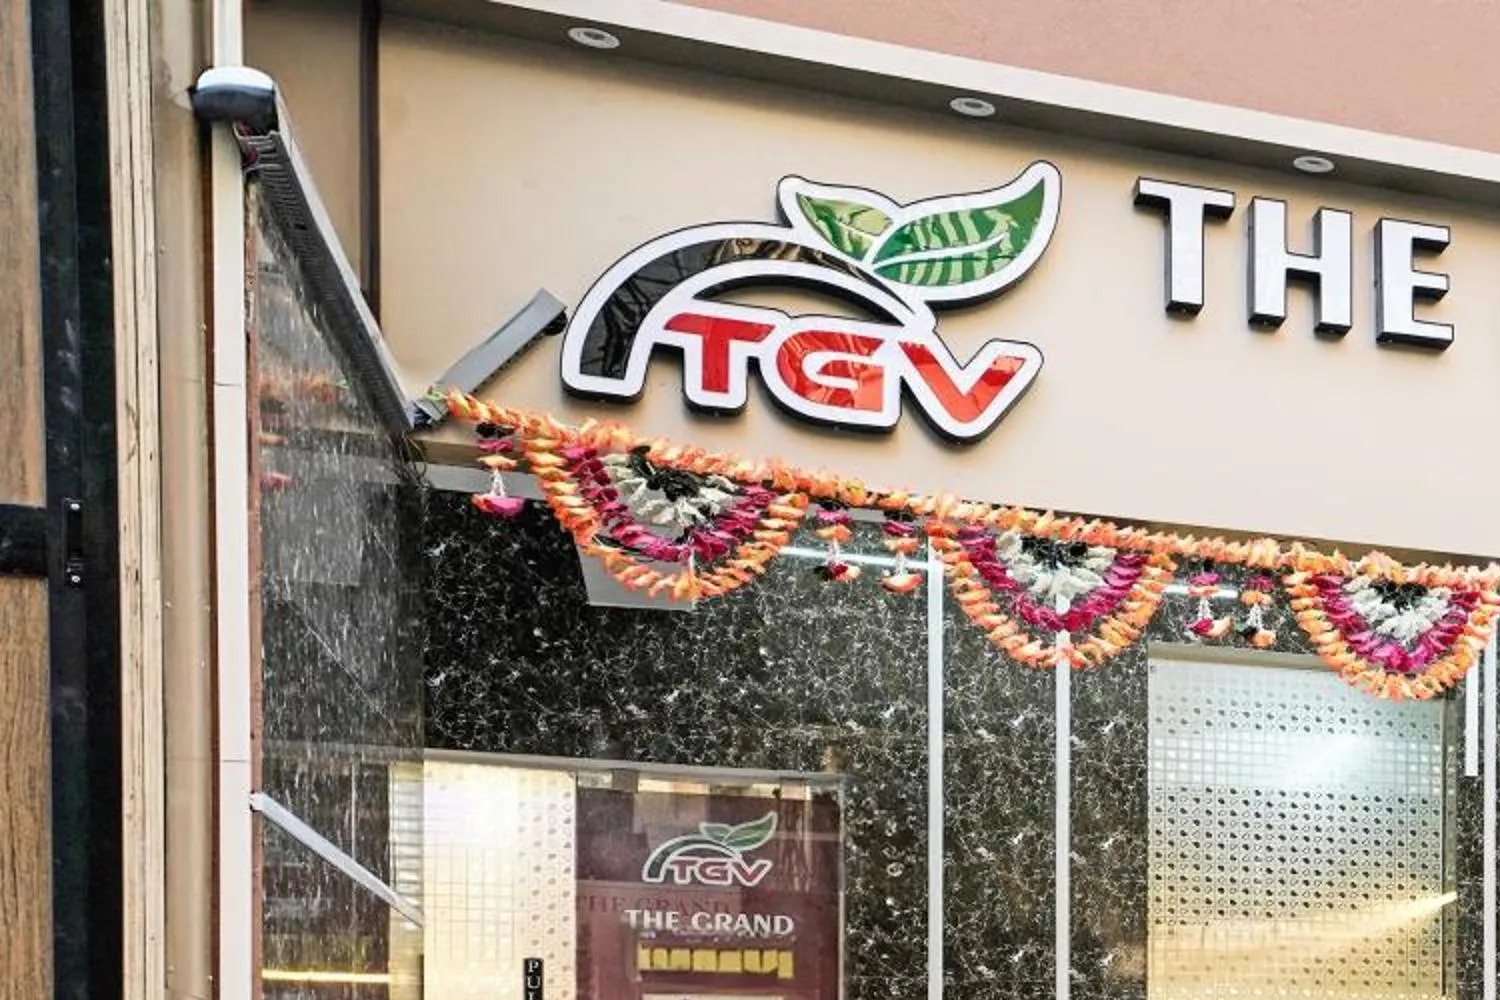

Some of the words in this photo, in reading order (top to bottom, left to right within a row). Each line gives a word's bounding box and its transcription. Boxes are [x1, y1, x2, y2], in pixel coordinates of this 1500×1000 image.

[1134, 176, 1455, 350] THE
[658, 308, 1042, 442] TGV
[668, 856, 773, 887] TGV
[623, 909, 680, 931] THE
[691, 911, 795, 936] GRAND
